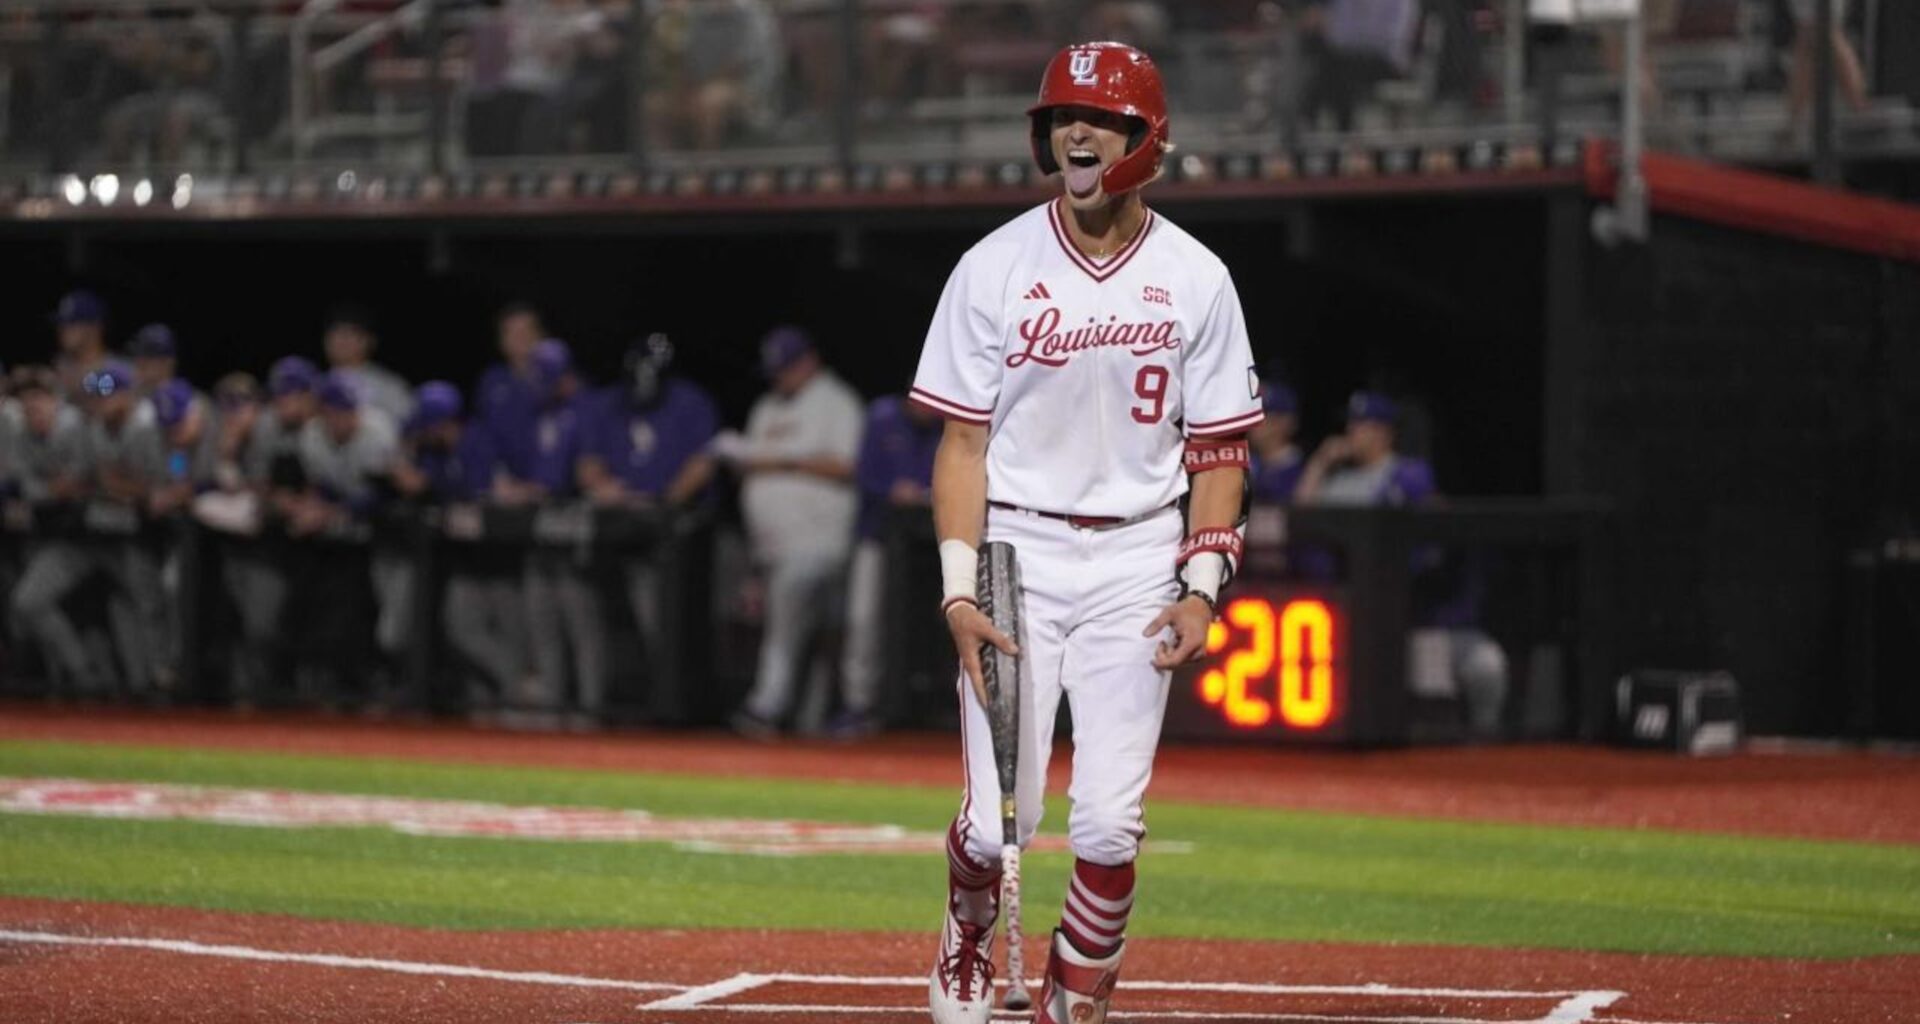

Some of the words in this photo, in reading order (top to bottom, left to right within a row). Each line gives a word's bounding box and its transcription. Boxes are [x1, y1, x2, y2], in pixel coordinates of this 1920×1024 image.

[1006, 308, 1180, 368] Louisiana
[1131, 365, 1169, 424] 9
[1185, 447, 1249, 465] RAGI
